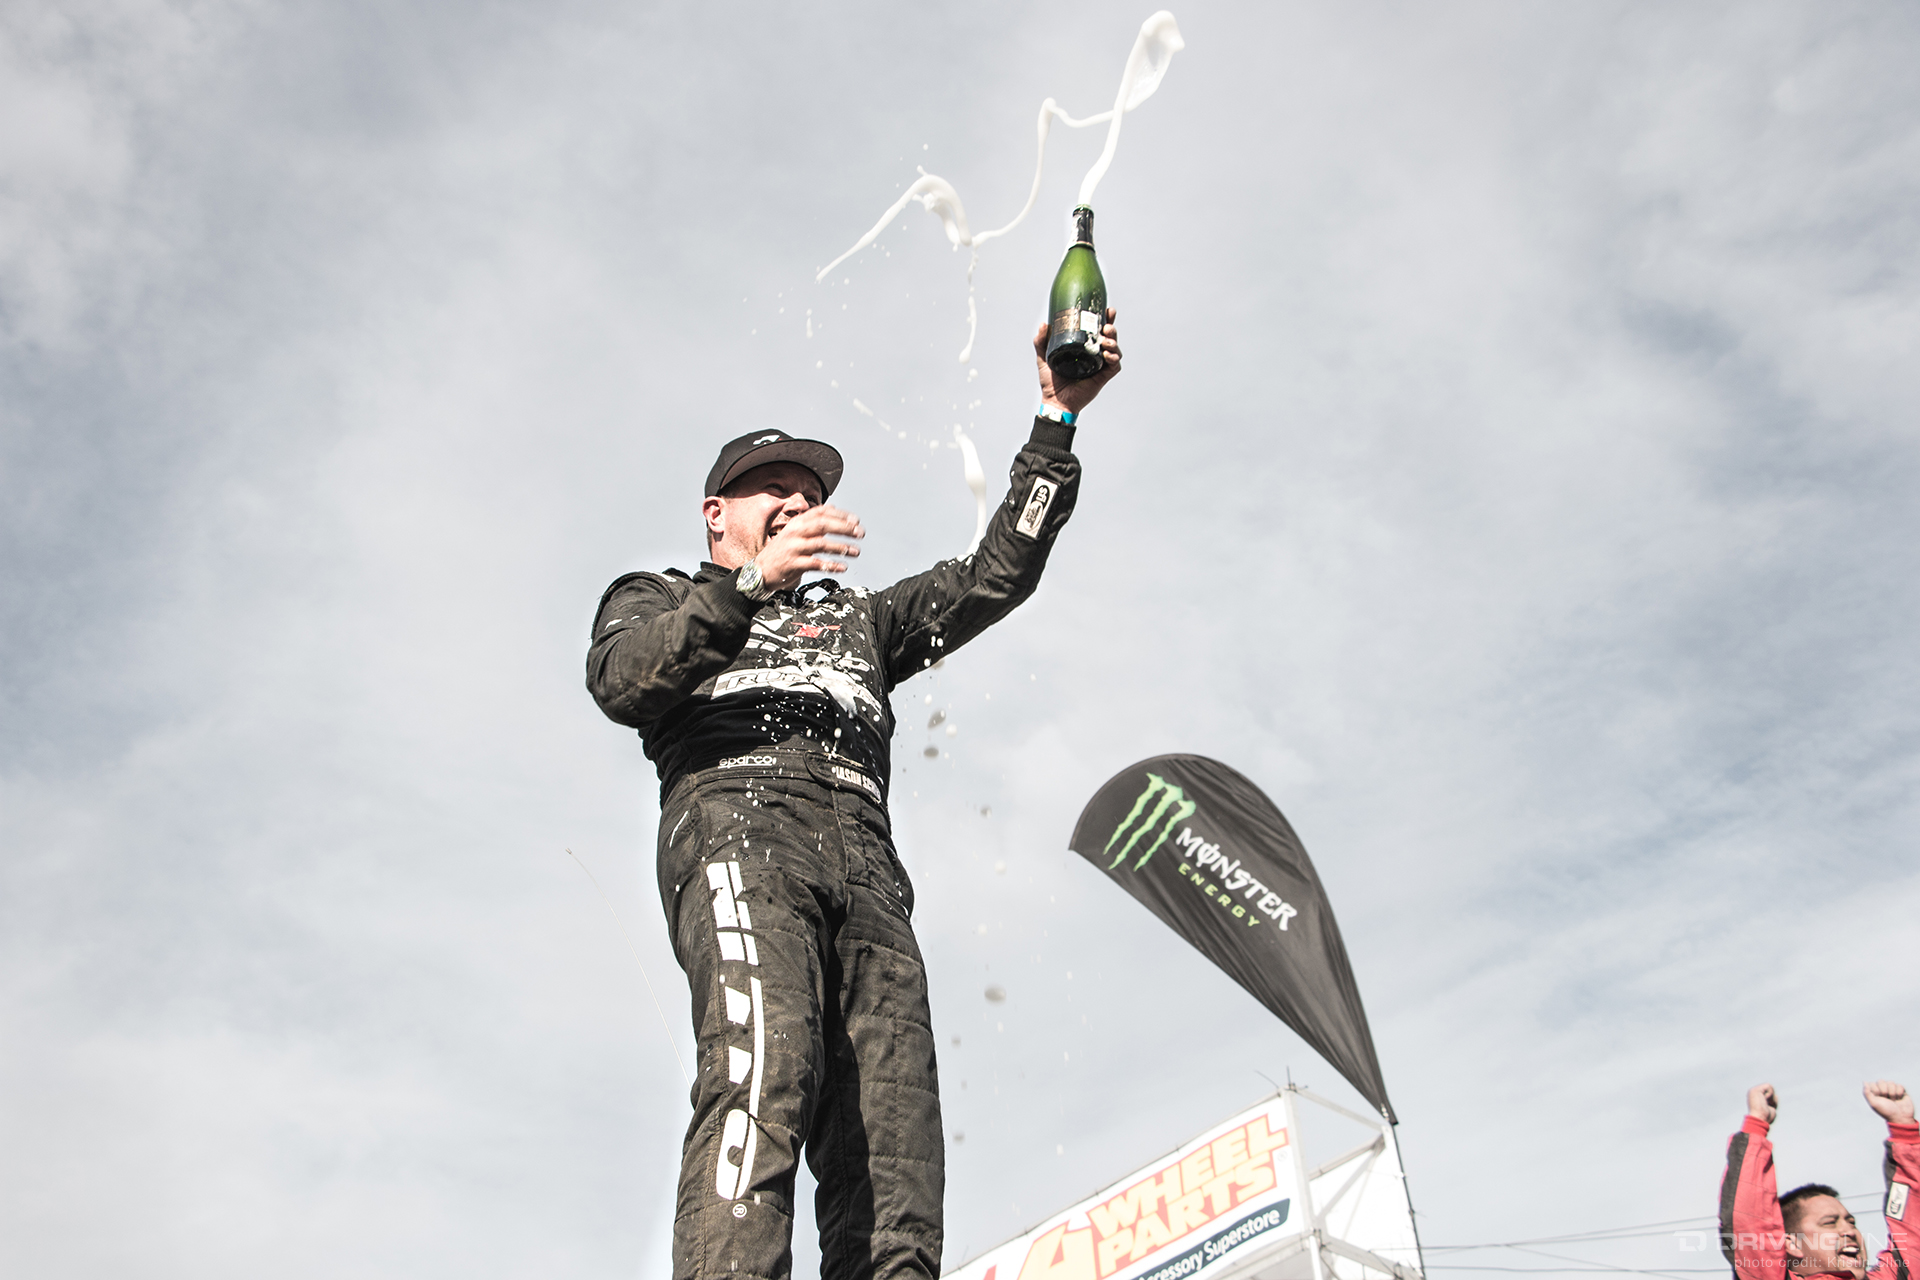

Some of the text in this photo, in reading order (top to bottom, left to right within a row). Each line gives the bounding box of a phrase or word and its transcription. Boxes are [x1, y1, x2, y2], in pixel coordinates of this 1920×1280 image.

[718, 755, 773, 769] sparco
[1178, 862, 1260, 928] ENERGY
[1086, 1113, 1288, 1241] WHEEL
[1098, 1151, 1277, 1278] PARTS
[1203, 1209, 1281, 1262] Superstore
